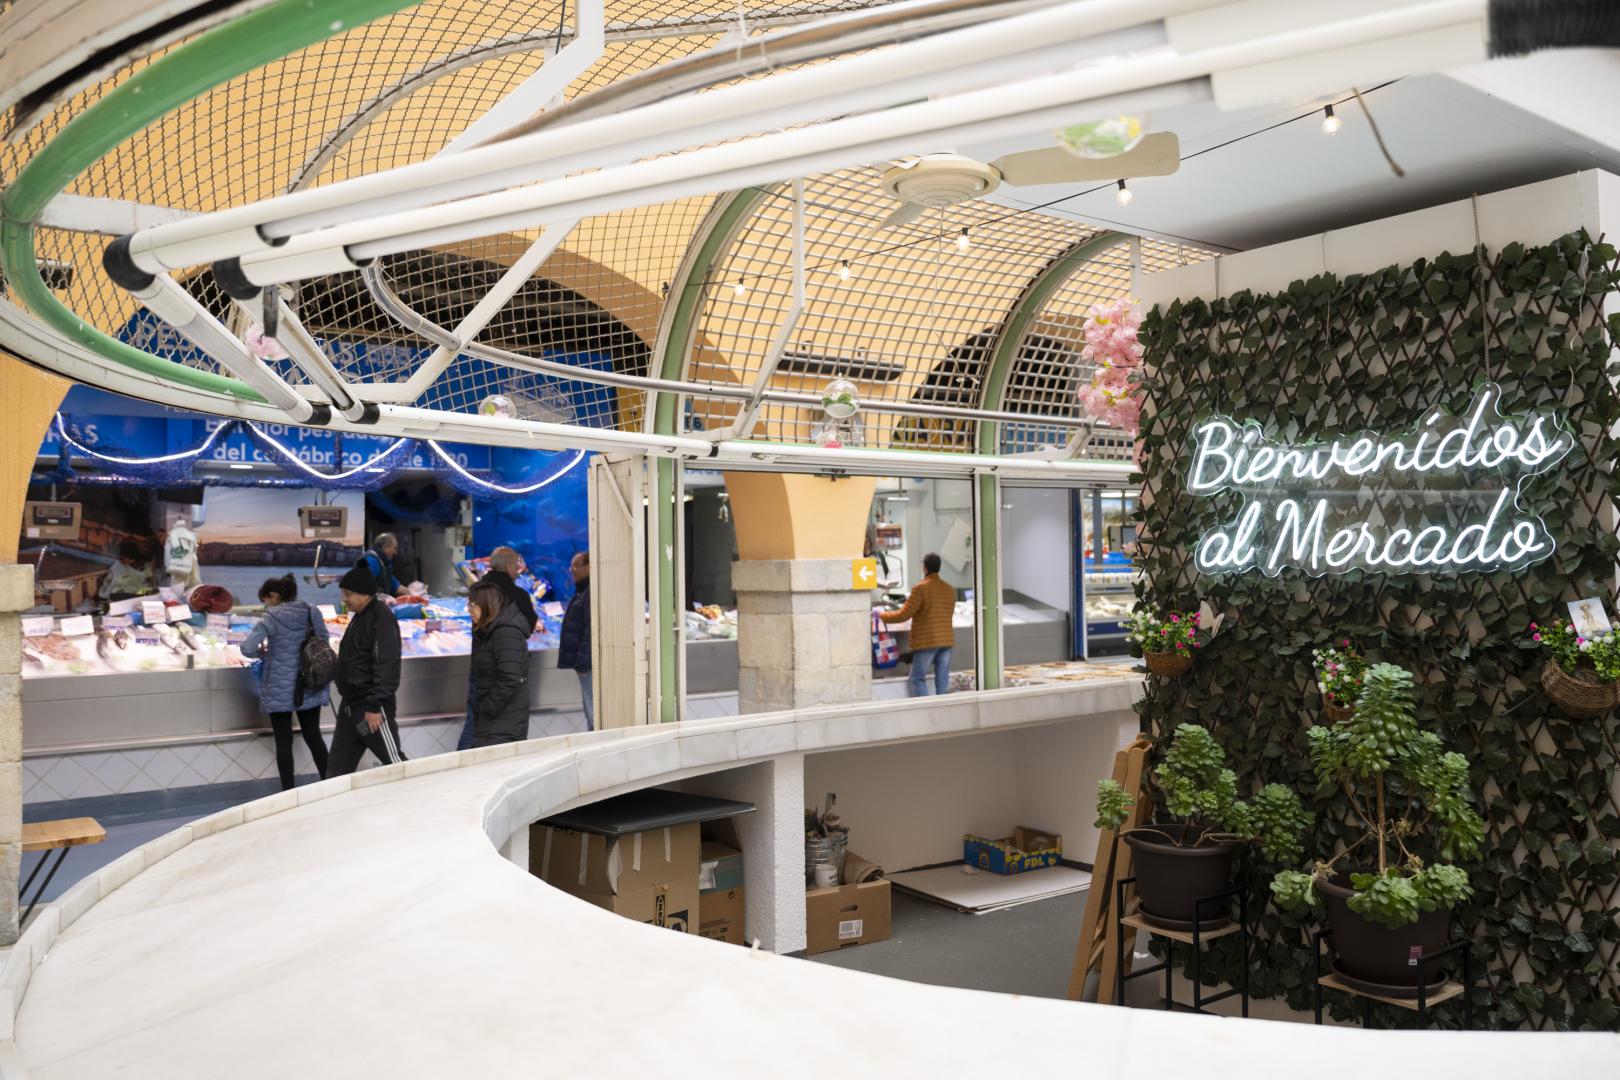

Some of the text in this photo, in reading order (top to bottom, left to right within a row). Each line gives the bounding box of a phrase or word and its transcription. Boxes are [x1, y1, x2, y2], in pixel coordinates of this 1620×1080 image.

[214, 442, 246, 461] del
[252, 445, 363, 465] ctábrco
[367, 448, 424, 468] dde
[1193, 390, 1562, 489] Bienvenidos
[1200, 486, 1545, 570] al Mercado
